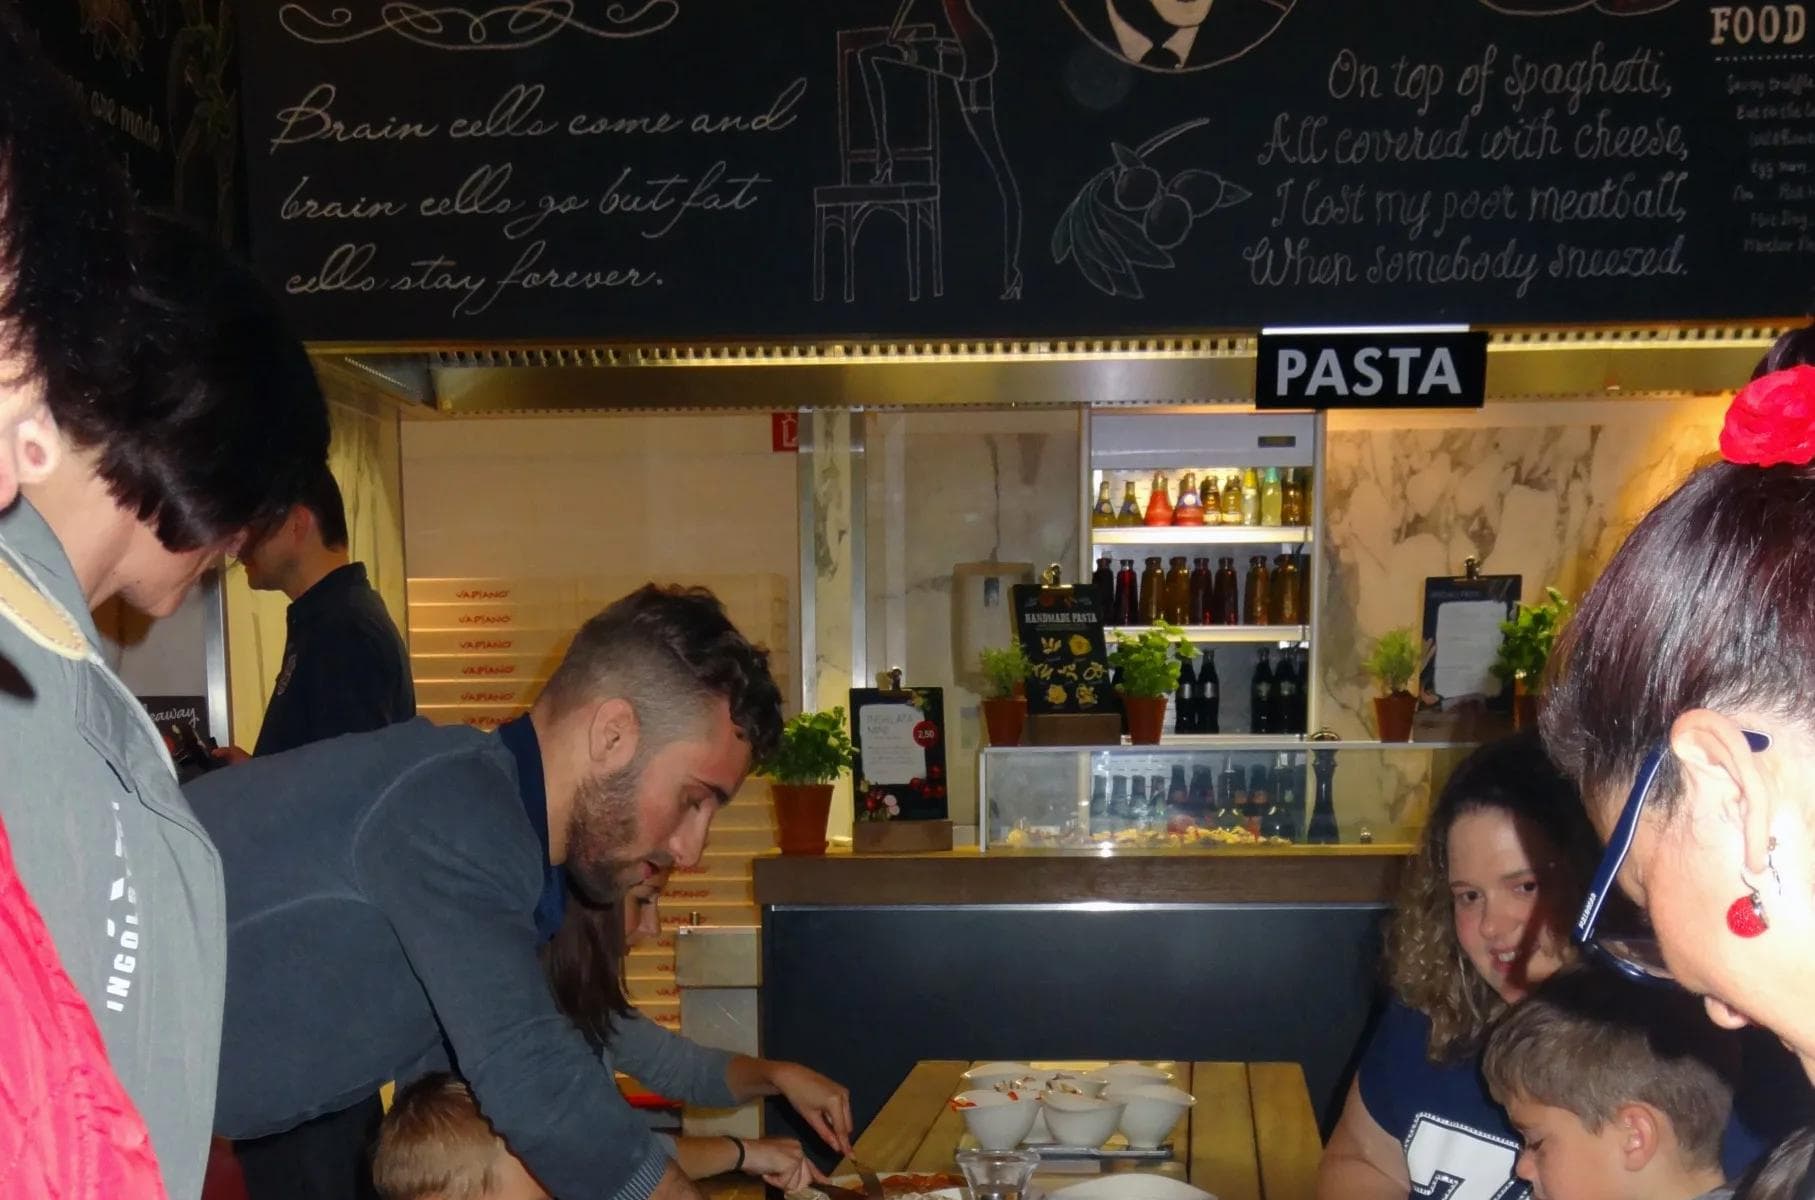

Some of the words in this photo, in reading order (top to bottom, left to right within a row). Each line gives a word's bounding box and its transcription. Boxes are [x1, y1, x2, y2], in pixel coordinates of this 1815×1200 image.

[1709, 5, 1807, 46] FOOD
[1328, 48, 1382, 101] On
[1395, 56, 1445, 118] top
[1456, 44, 1497, 118] of
[270, 83, 438, 154] Brain
[448, 83, 560, 139] cells
[567, 112, 686, 138] come
[690, 77, 808, 132] and
[1257, 112, 1330, 164] All
[1334, 116, 1471, 164] covered
[1480, 112, 1564, 160] with
[1573, 107, 1691, 162] cheese,
[280, 174, 408, 220] brain
[418, 160, 520, 214] cells
[597, 166, 690, 212] but
[640, 160, 774, 239] fat
[1302, 184, 1366, 226] lost
[1374, 188, 1432, 240] my
[1432, 190, 1520, 238] poor
[1527, 170, 1690, 224] meatball,
[502, 194, 592, 240] go
[284, 243, 388, 294] cells
[390, 256, 488, 319] stay
[448, 240, 666, 316] forever.
[1241, 235, 1358, 288] When
[1367, 234, 1542, 300] somebody
[1274, 346, 1464, 397] PASTA
[455, 589, 510, 600] VAPIANO
[458, 614, 512, 624] VAPIANO
[1071, 612, 1099, 624] PASTA
[460, 640, 513, 650] VAPIANO
[462, 664, 516, 676] VAPIANO
[461, 691, 515, 702] VAPIANO
